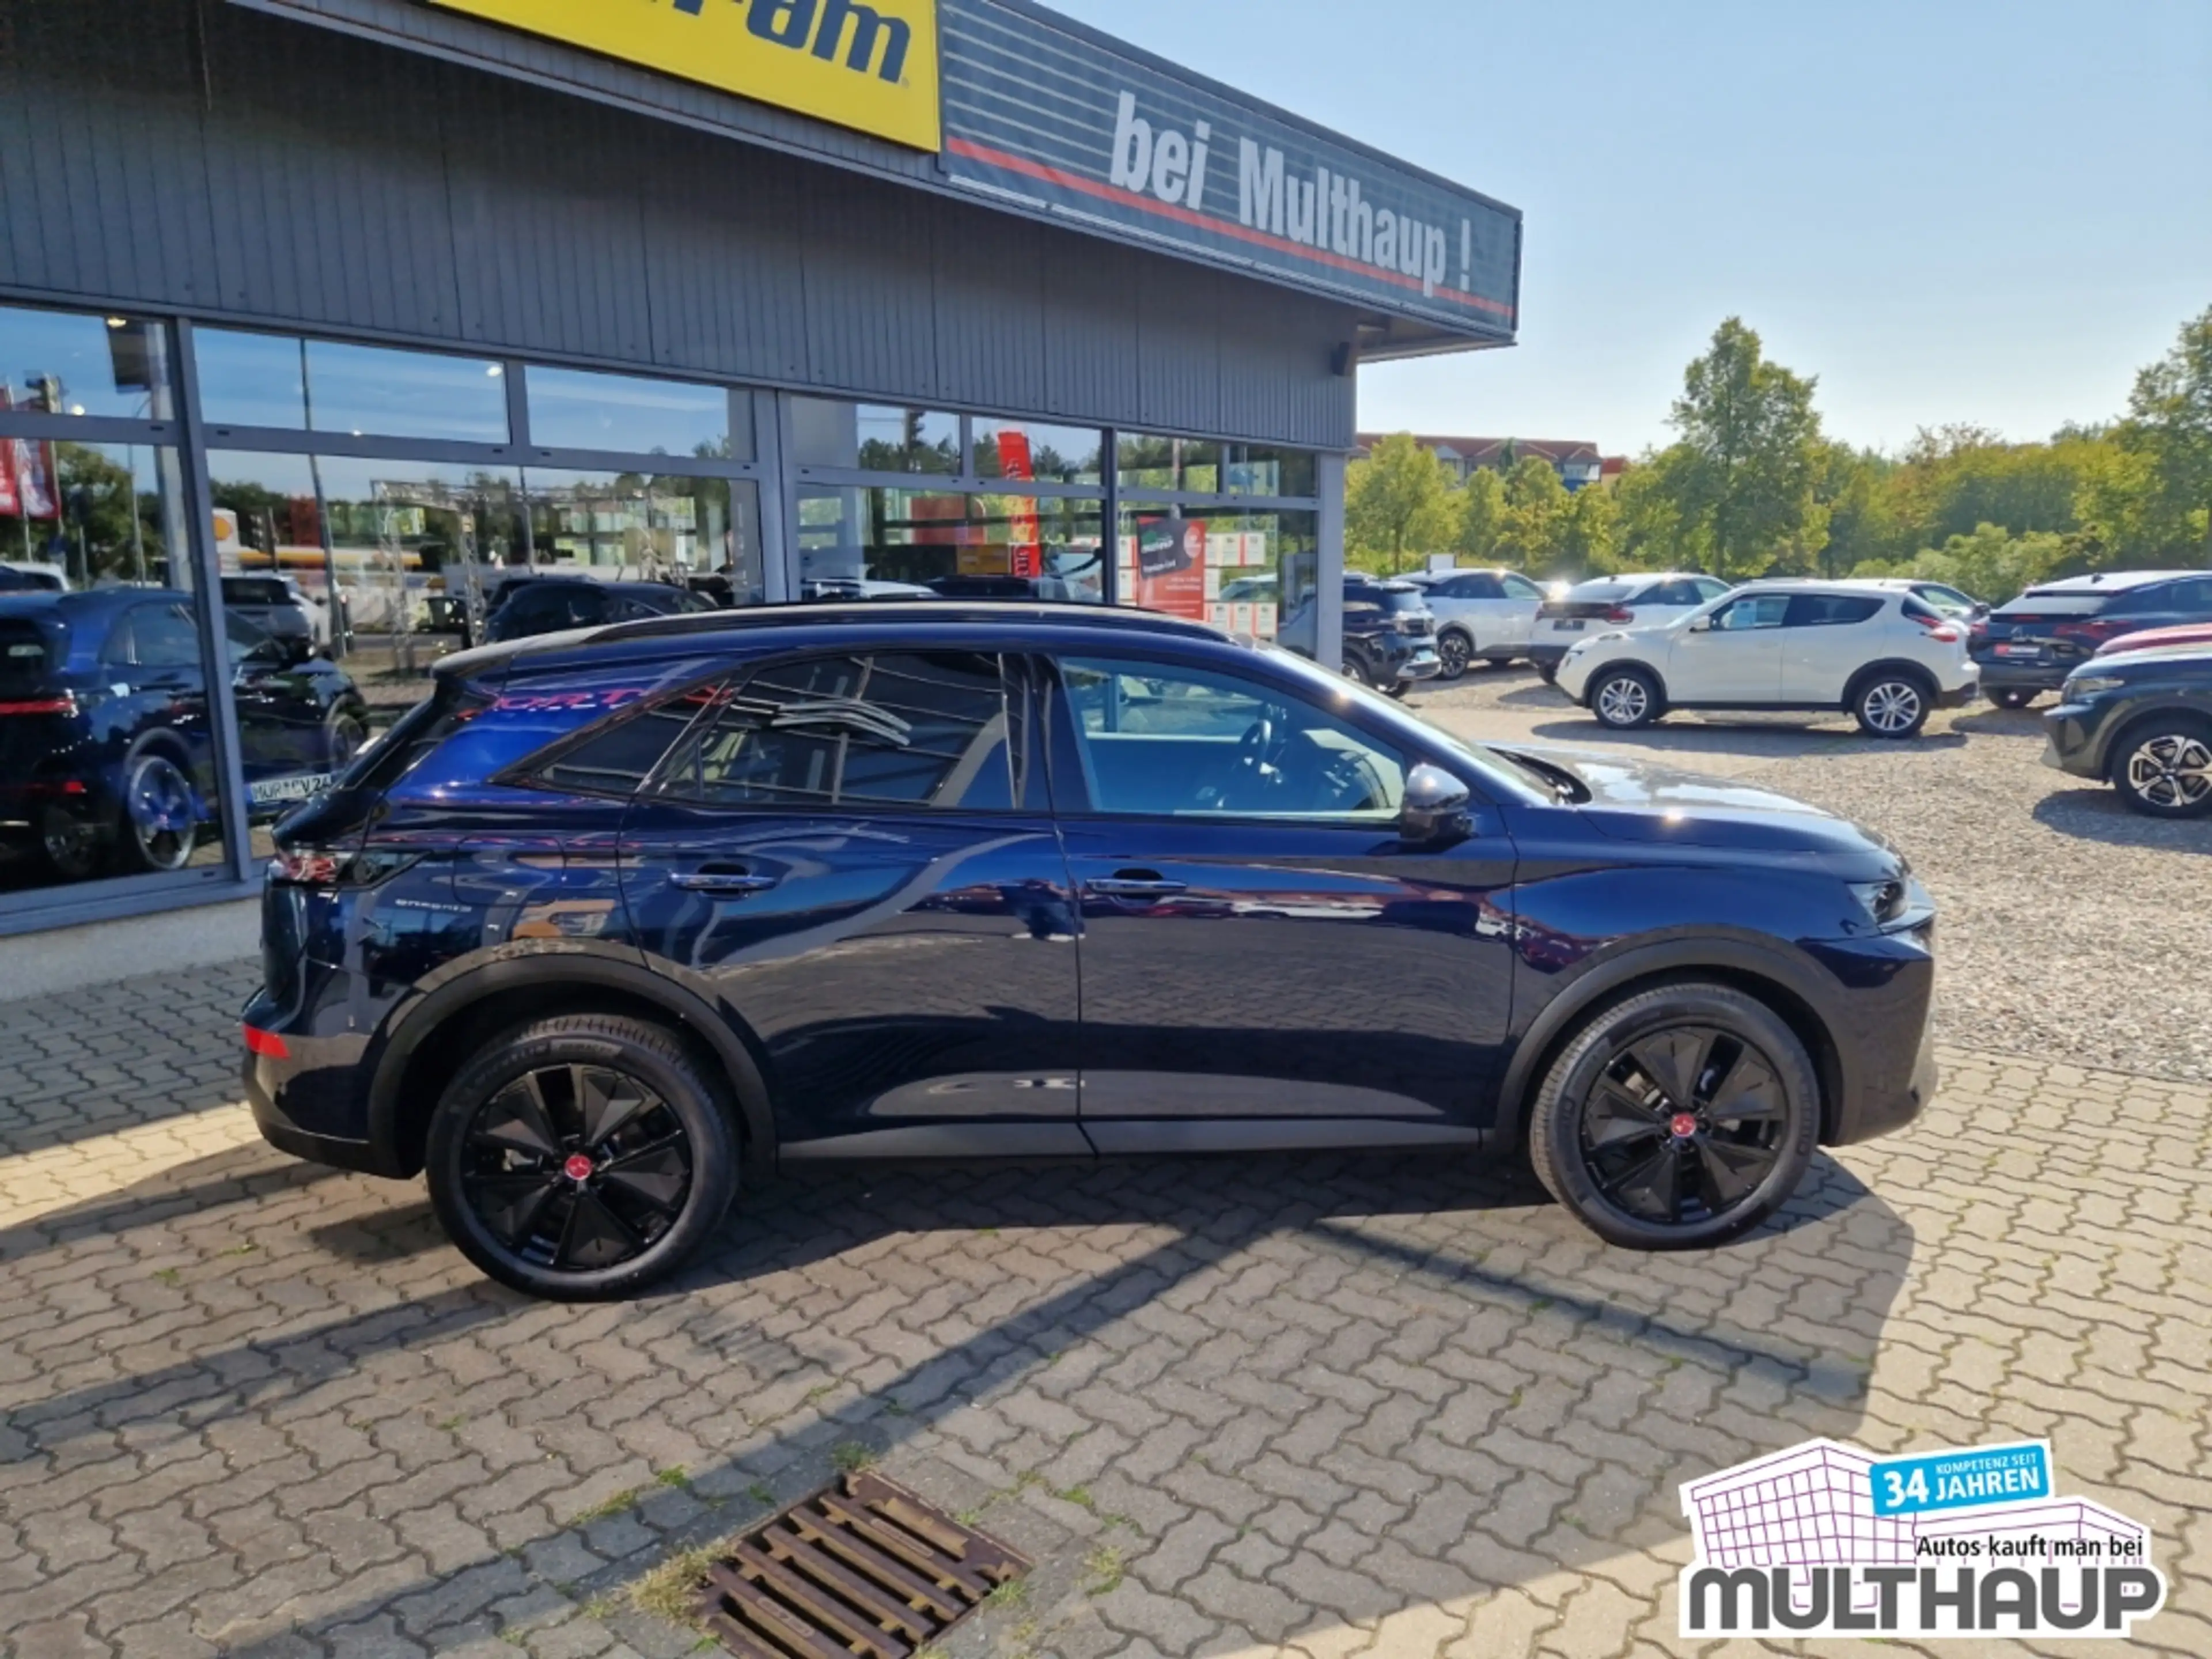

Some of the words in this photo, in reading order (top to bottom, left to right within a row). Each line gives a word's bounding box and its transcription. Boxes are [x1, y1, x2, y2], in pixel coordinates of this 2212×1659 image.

[1109, 90, 1210, 211] bei
[1239, 136, 1446, 298] Multhaup
[1460, 219, 1471, 292] !
